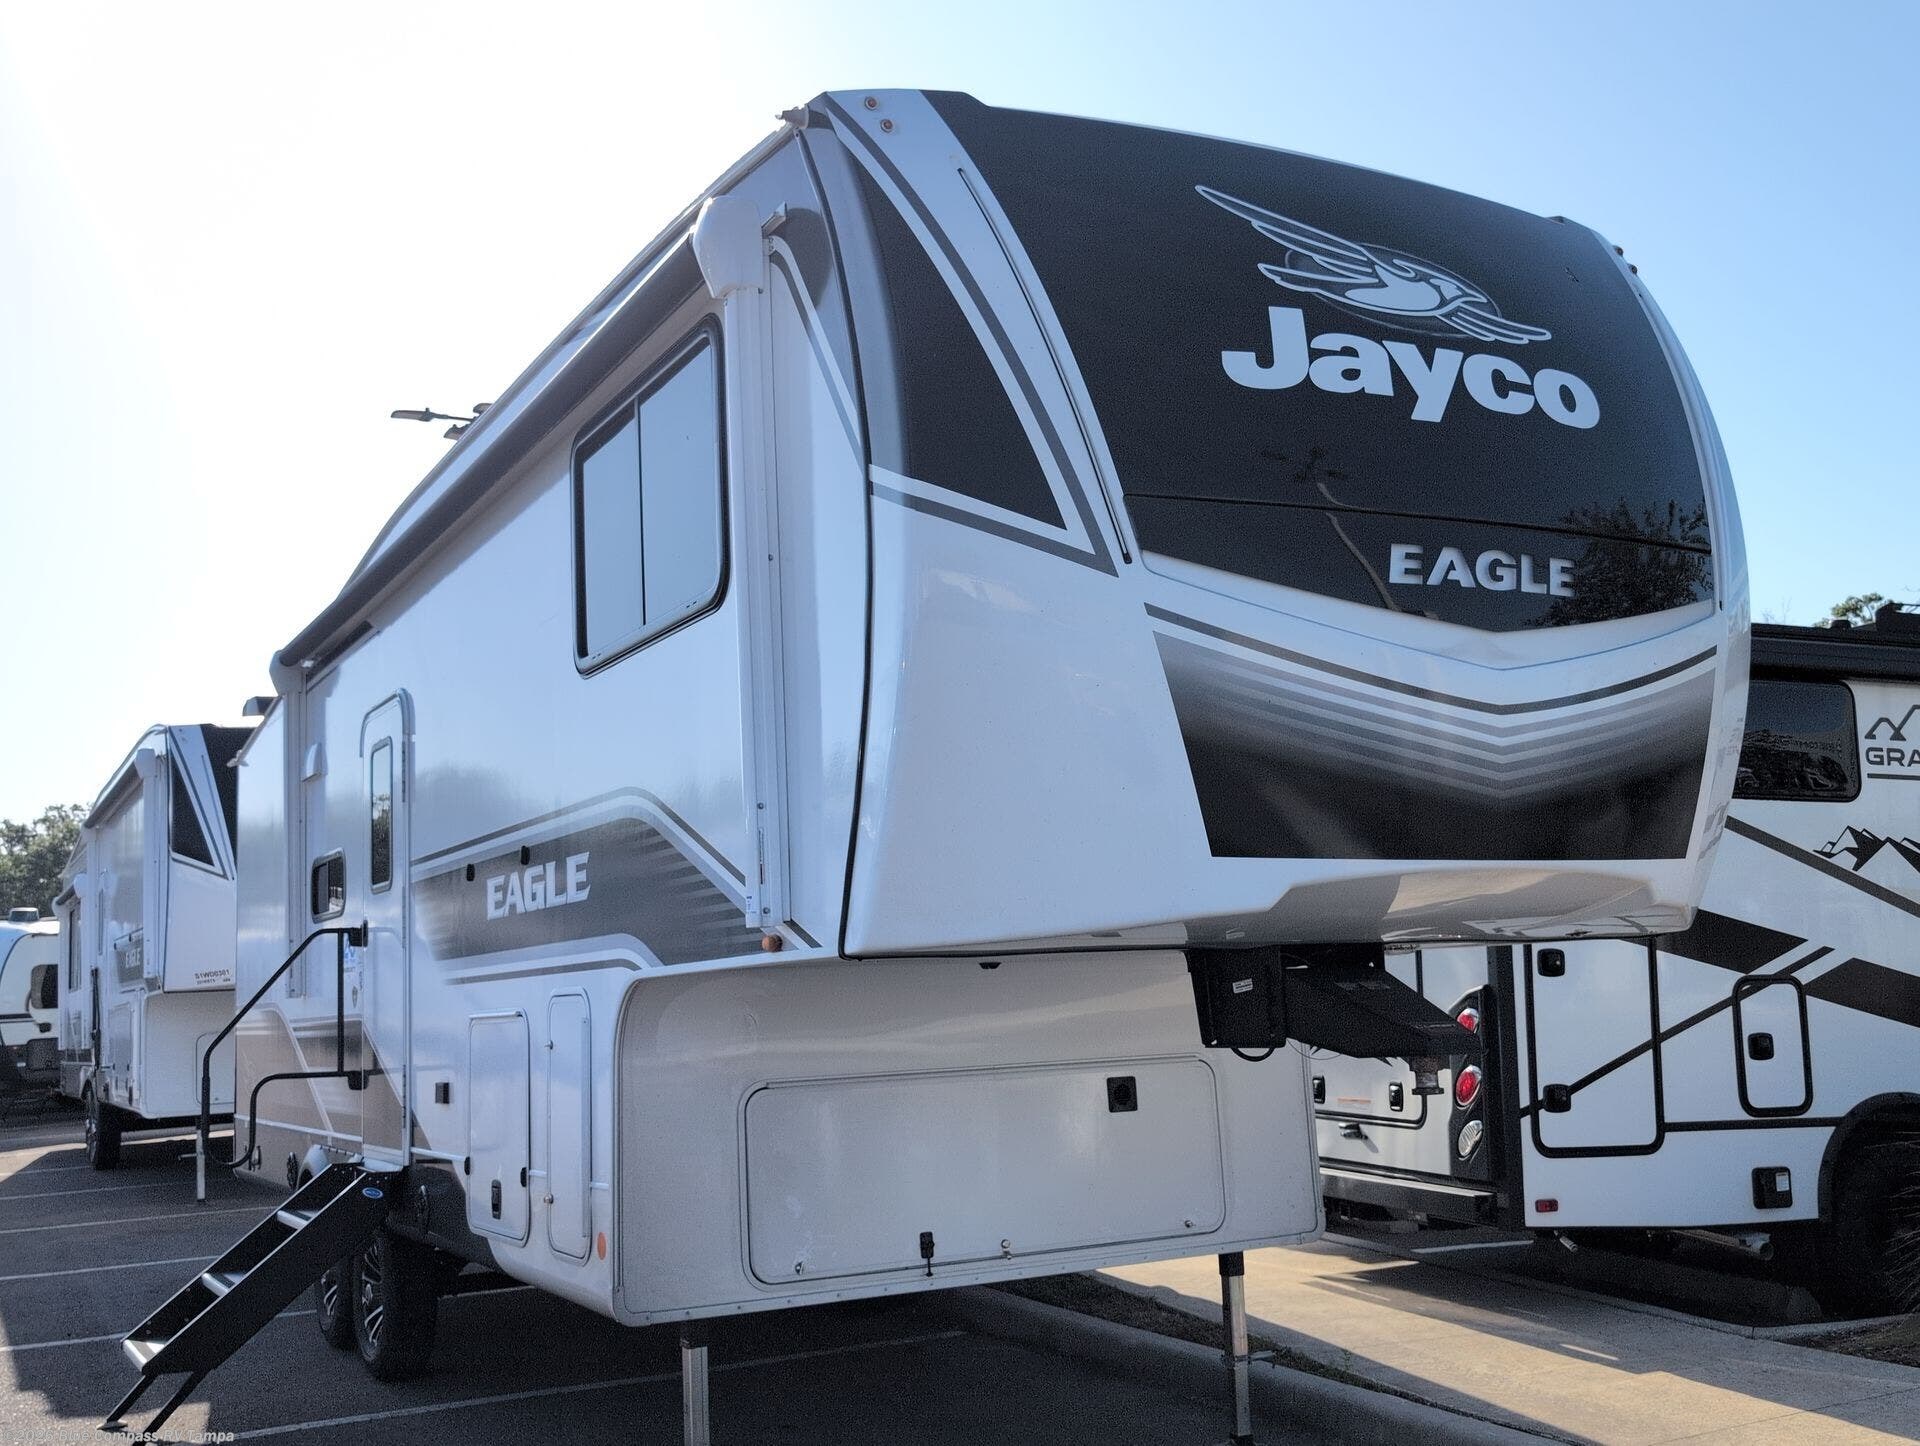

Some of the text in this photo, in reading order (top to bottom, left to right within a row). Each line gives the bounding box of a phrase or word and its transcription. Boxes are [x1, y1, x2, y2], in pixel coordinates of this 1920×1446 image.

[1221, 306, 1600, 429] Jayco
[1389, 543, 1576, 597] EAGLE
[1865, 746, 1920, 767] GRA
[486, 851, 591, 920] EAGLE
